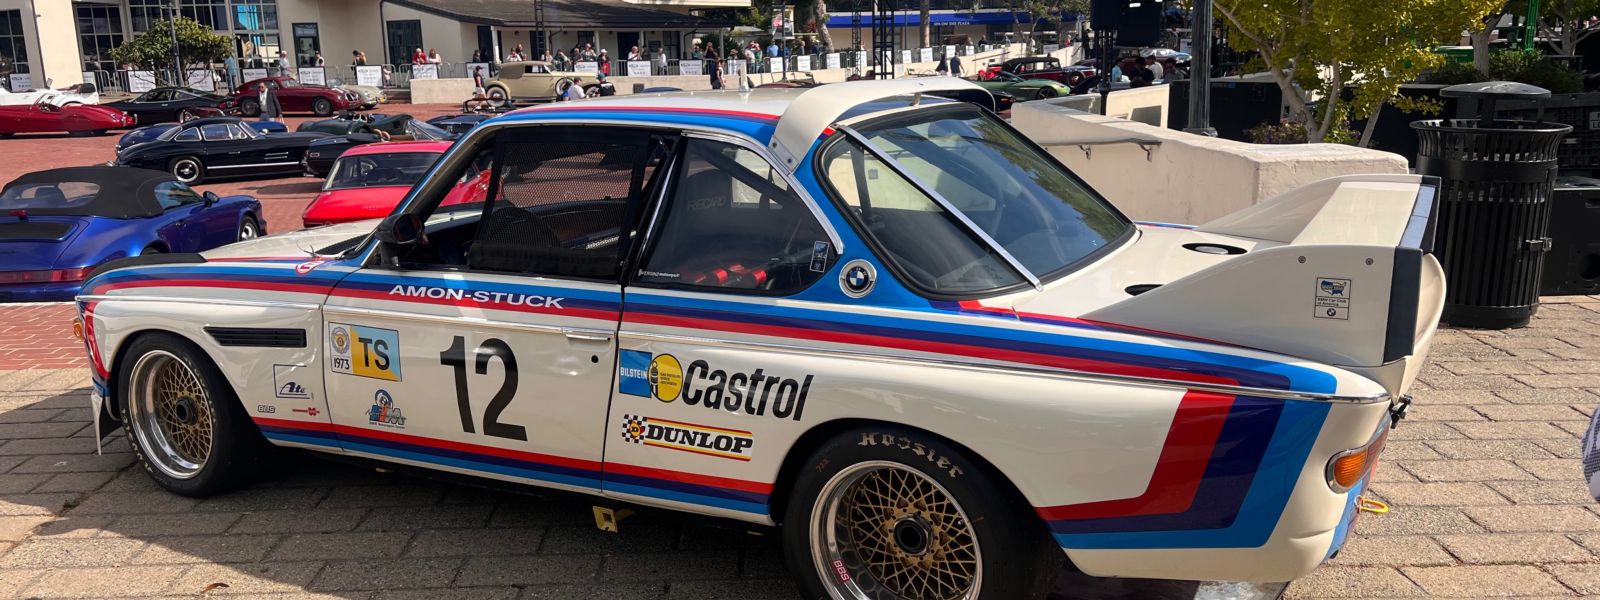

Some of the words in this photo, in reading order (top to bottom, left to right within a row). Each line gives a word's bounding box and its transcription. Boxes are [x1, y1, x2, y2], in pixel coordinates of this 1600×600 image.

[389, 284, 565, 310] AMON-STUCK
[333, 357, 350, 370] 1973
[358, 336, 390, 371] TS
[620, 366, 648, 380] BILSTEIN
[440, 335, 529, 442] 12
[681, 359, 815, 422] Castrol
[645, 423, 754, 454] DUNLOP
[833, 560, 850, 581] BBS
